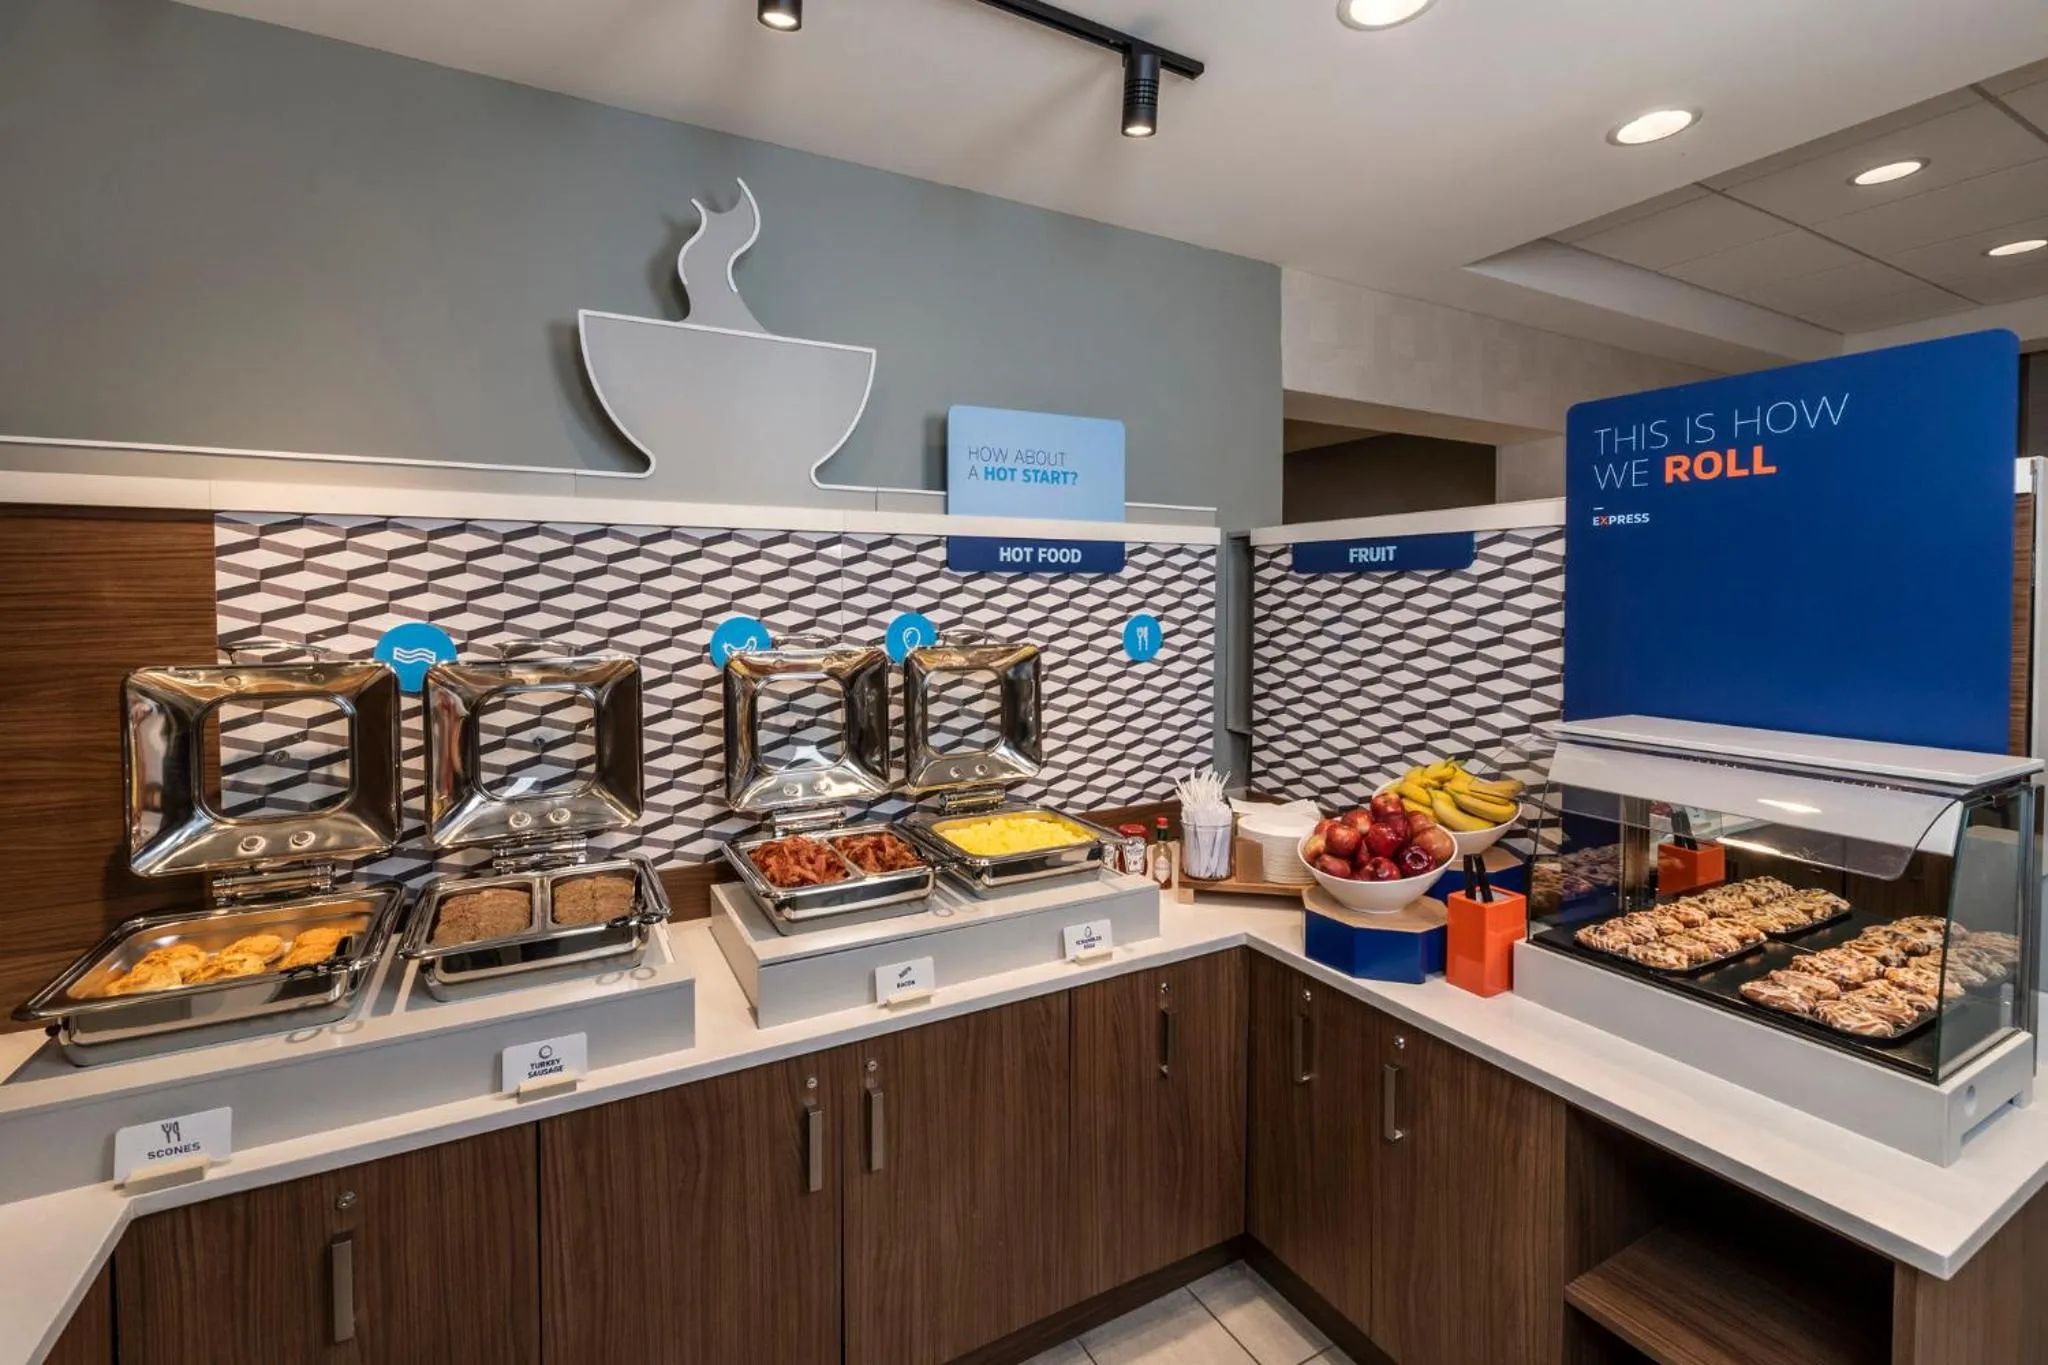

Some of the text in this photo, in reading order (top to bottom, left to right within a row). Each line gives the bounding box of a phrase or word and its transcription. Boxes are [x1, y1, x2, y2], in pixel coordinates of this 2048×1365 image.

[1594, 393, 1849, 456] THIS IS HOW
[968, 447, 1067, 467] HOW ABOUT
[968, 466, 1078, 485] A HOT START?
[1594, 445, 1777, 490] WE ROLL
[1592, 513, 1650, 526] EXPRESS
[1000, 547, 1081, 564] HOT FOOD
[1349, 545, 1398, 563] FRUIT
[528, 1065, 563, 1078] SAUSAGE
[530, 1057, 561, 1069] TURKEY
[147, 1142, 201, 1160] SCONES
